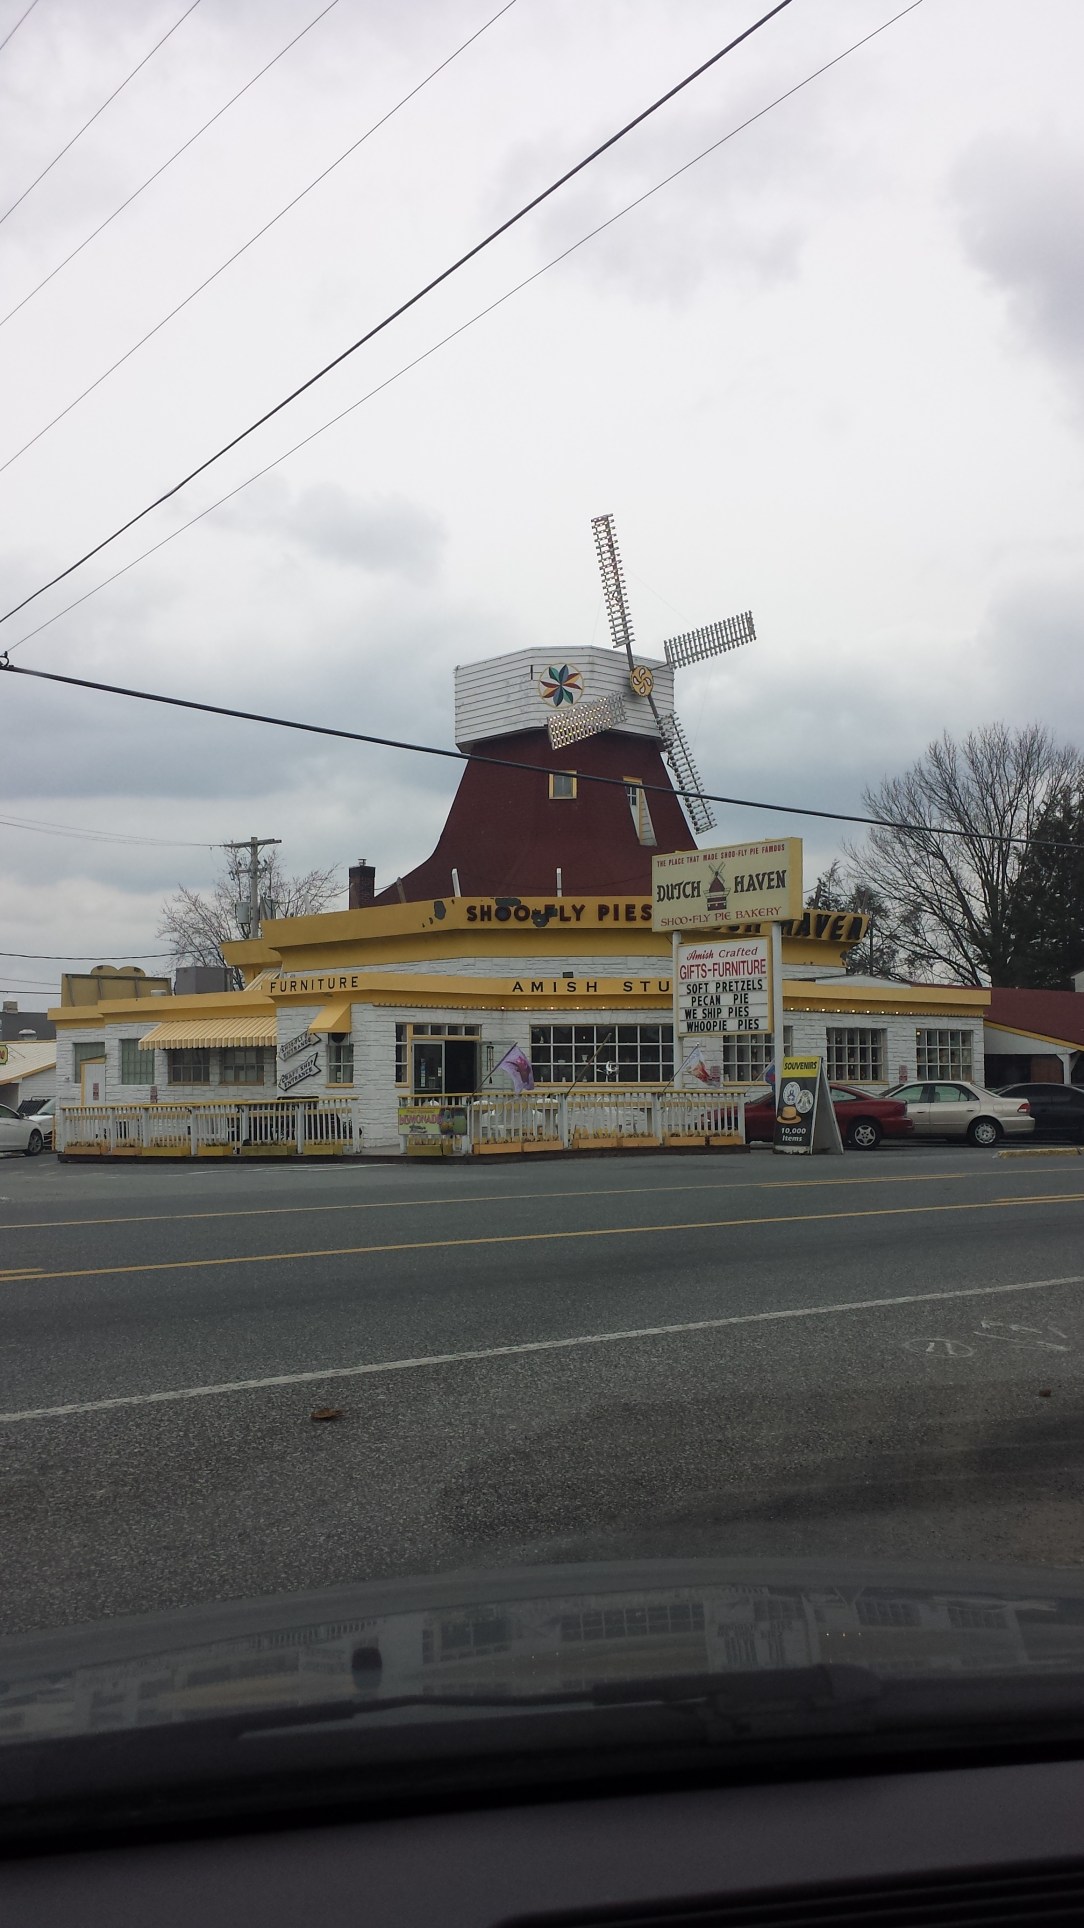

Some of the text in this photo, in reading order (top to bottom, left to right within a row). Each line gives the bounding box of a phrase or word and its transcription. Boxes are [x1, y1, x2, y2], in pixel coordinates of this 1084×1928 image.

[657, 859, 666, 868] THE
[668, 857, 684, 866] PLACE
[686, 855, 699, 864] THAT
[702, 853, 718, 862] MADE
[749, 847, 759, 856] PIE
[761, 843, 785, 854] FAMOUS
[656, 869, 787, 903] DUTCH HAVEN
[597, 903, 652, 922] PIES
[714, 911, 732, 921] PIE
[735, 905, 782, 918] BAKERY
[686, 946, 758, 961] Amish Crafted
[679, 958, 767, 980] GIFTS-FURNITURE
[270, 976, 359, 993] FURNITURE
[512, 981, 598, 993] AMISH
[686, 979, 763, 995] SOFT PRETZELS
[691, 993, 749, 1007] PECAN PIE
[684, 1006, 749, 1019] WE SHIP PIES
[686, 1018, 760, 1032] WHOOPIE PIES
[784, 1061, 817, 1070] SOUVENIRS
[284, 1066, 313, 1088] ENTRANCE
[781, 1127, 806, 1135] 10,000
